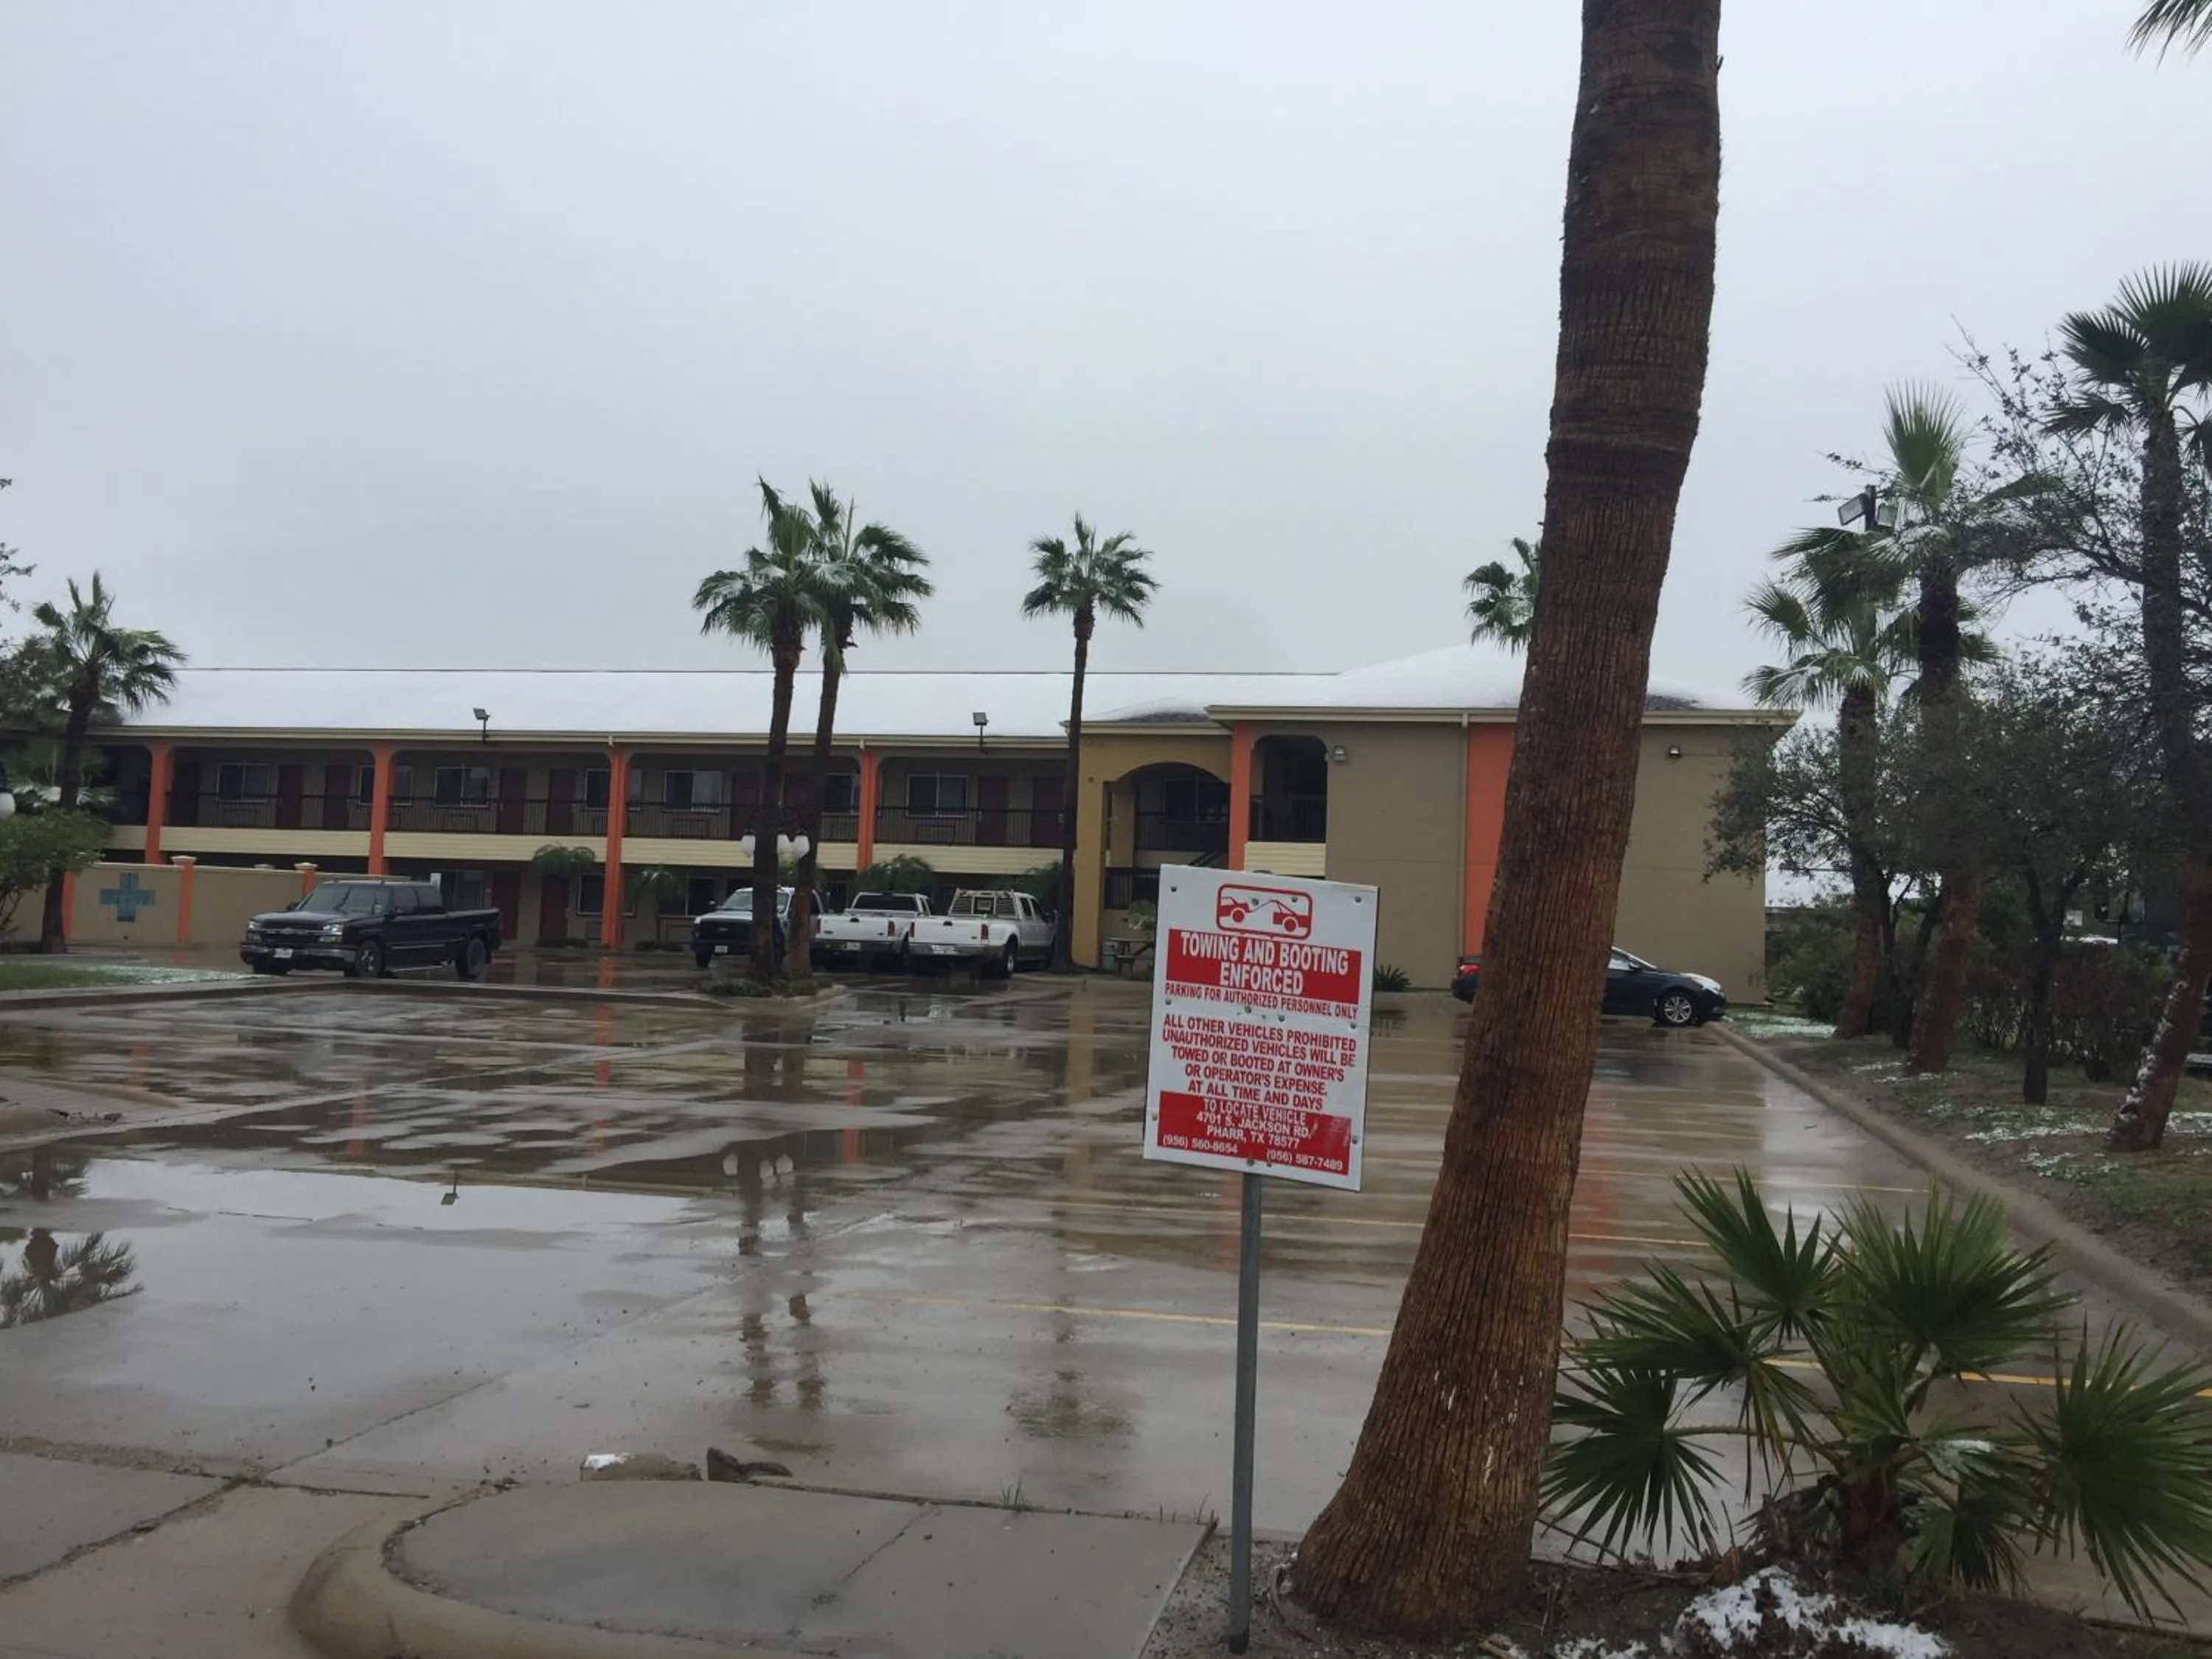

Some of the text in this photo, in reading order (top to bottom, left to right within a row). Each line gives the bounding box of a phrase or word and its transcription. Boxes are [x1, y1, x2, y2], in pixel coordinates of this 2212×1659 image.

[1180, 931, 1349, 975] TOWING AND BOOTING
[1220, 962, 1304, 995] ENFORCED
[1164, 983, 1358, 1020] PARKING FOR AUTHORIZED PERSONNEL ONLY
[1162, 1029, 1357, 1068] UNAUTHORIZED VEHICLES WILL BE
[1164, 1014, 1357, 1052] ALL OTHER VEHICLES PROHIBITED
[1172, 1045, 1345, 1082] TOWED OR BOOTED AT OWNER'S
[1185, 1062, 1201, 1078] OR
[1203, 1065, 1271, 1088] OPERATOR'S
[1188, 1079, 1324, 1111] AT ALL TIME AND DAYS
[1196, 1110, 1222, 1125] 4701
[1225, 1114, 1235, 1127] S.
[1239, 1117, 1290, 1136] JACKSON
[1203, 1098, 1307, 1126] TO LOCATE VEHICLE
[1206, 1124, 1300, 1150] PHARR, TX 78577
